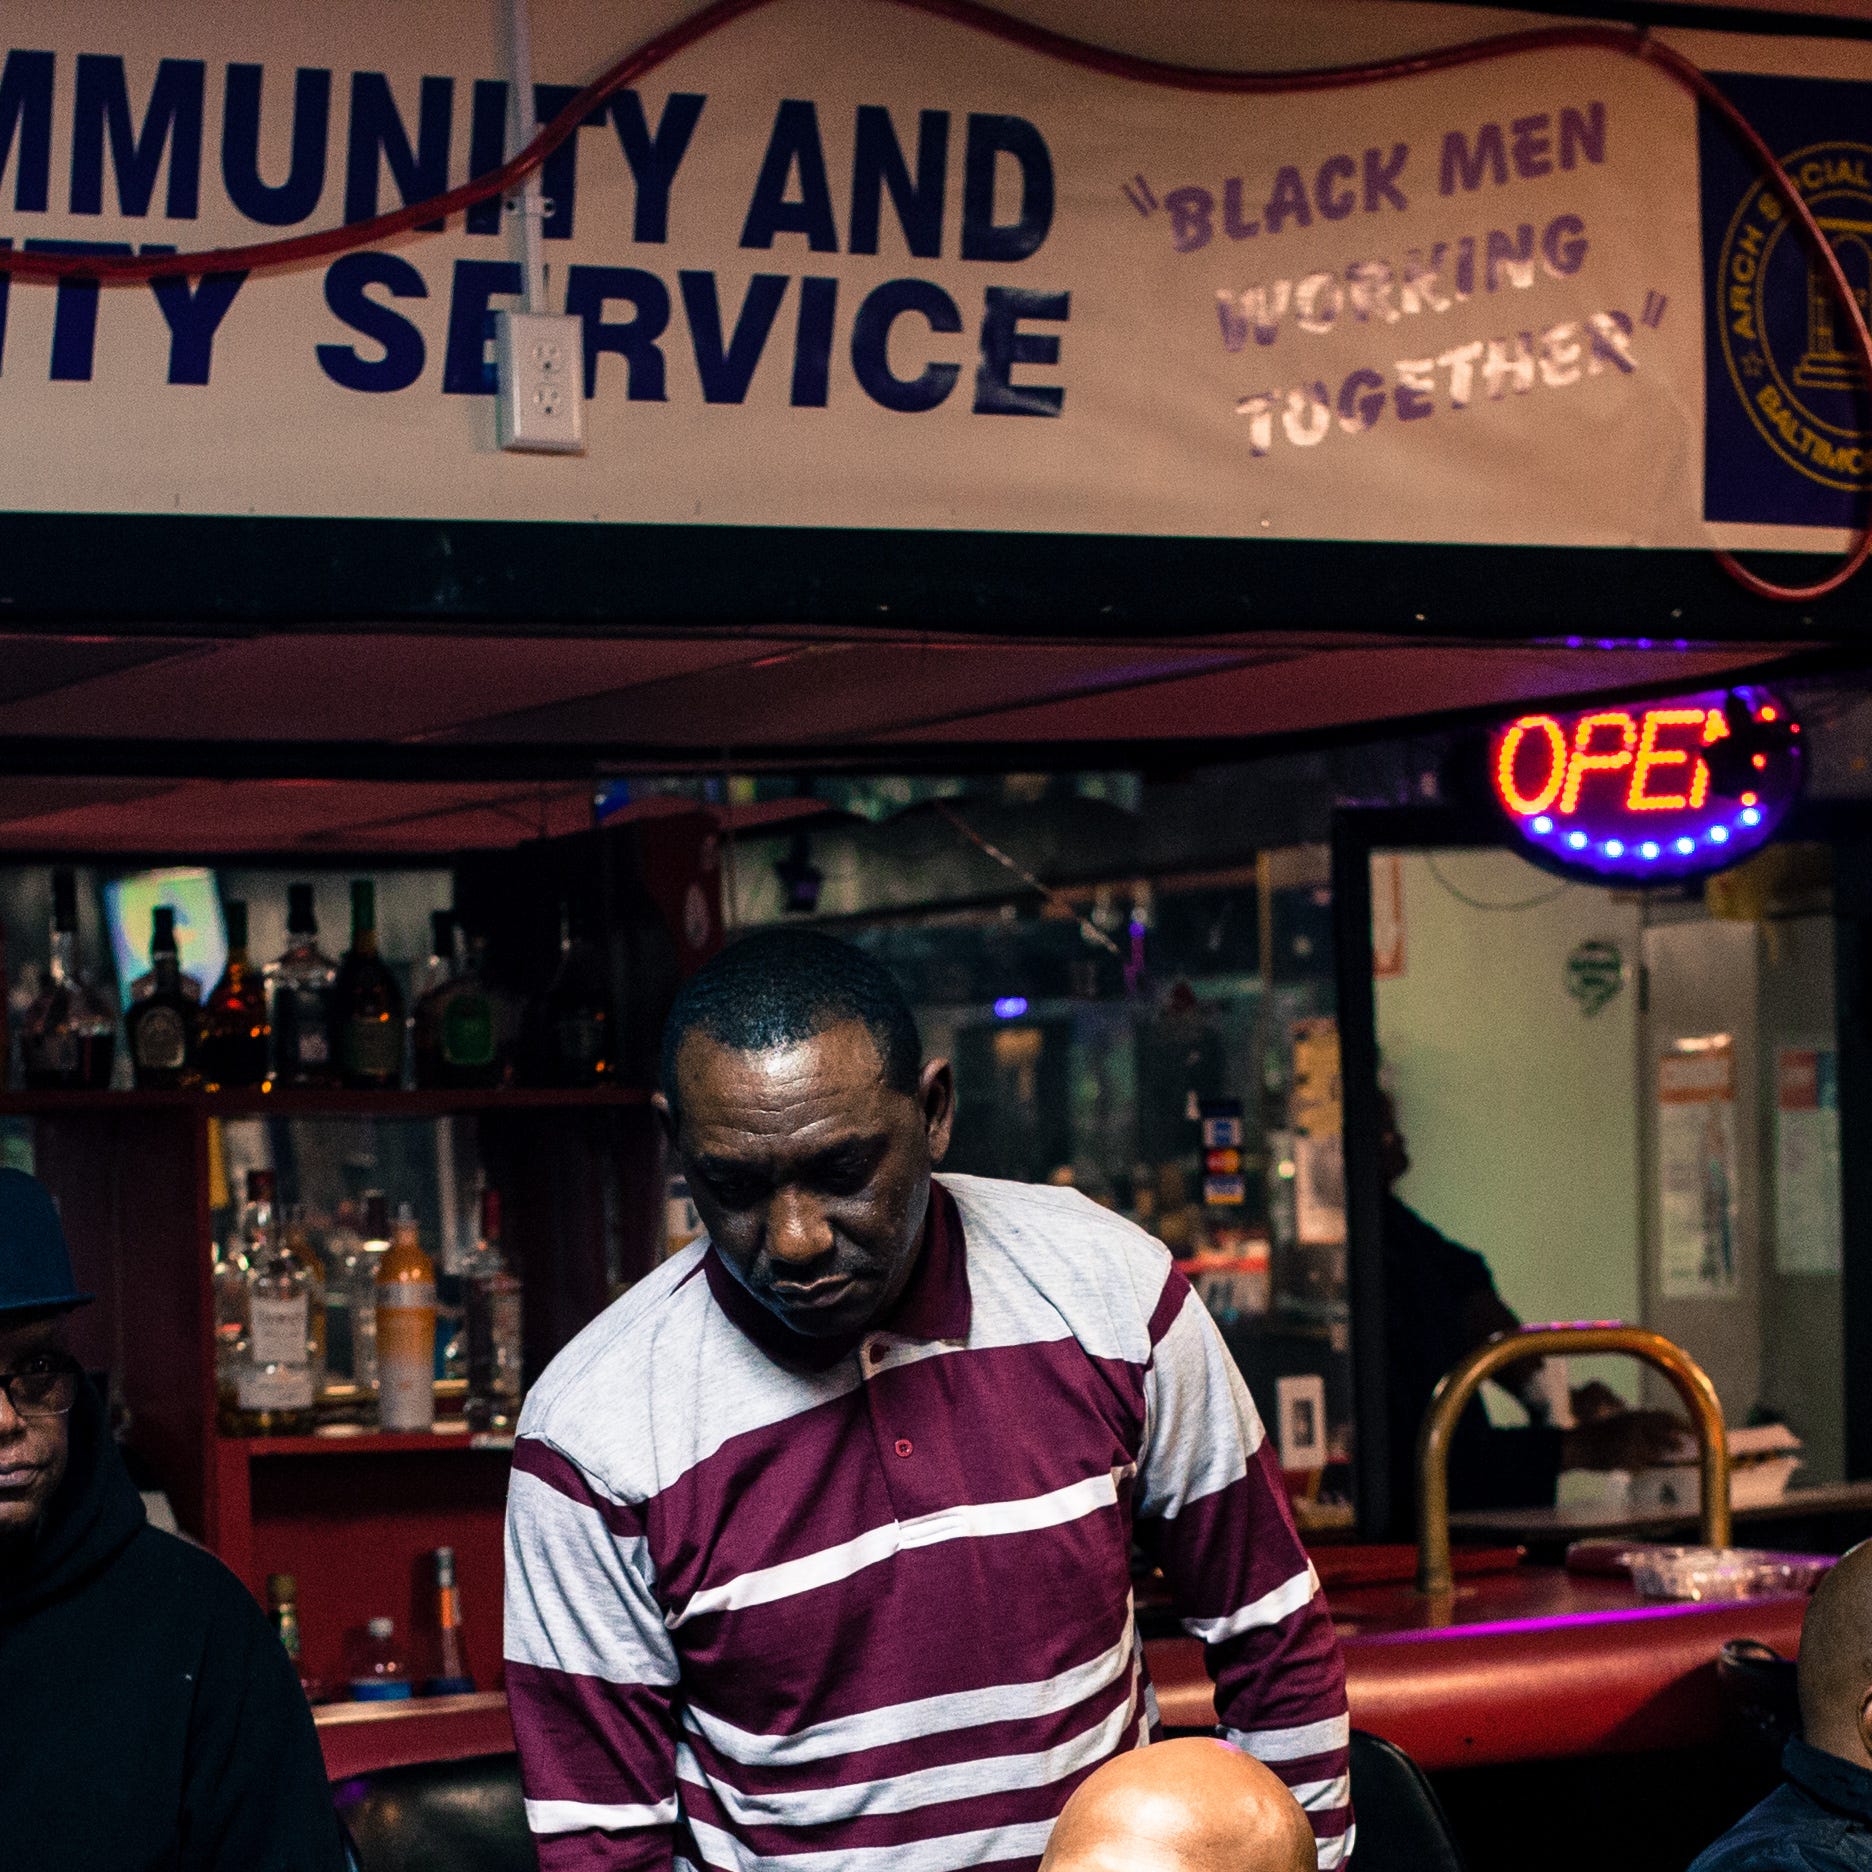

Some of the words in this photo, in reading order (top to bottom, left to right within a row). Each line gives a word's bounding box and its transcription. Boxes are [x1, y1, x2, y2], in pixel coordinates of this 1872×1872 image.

[739, 98, 1056, 263] AND
[1438, 101, 1607, 198] MEN
[1215, 214, 1589, 354] WORKING
[1730, 222, 1765, 341] ARCH
[1758, 158, 1872, 220] SCIAL
[315, 250, 1070, 418] SERVICE
